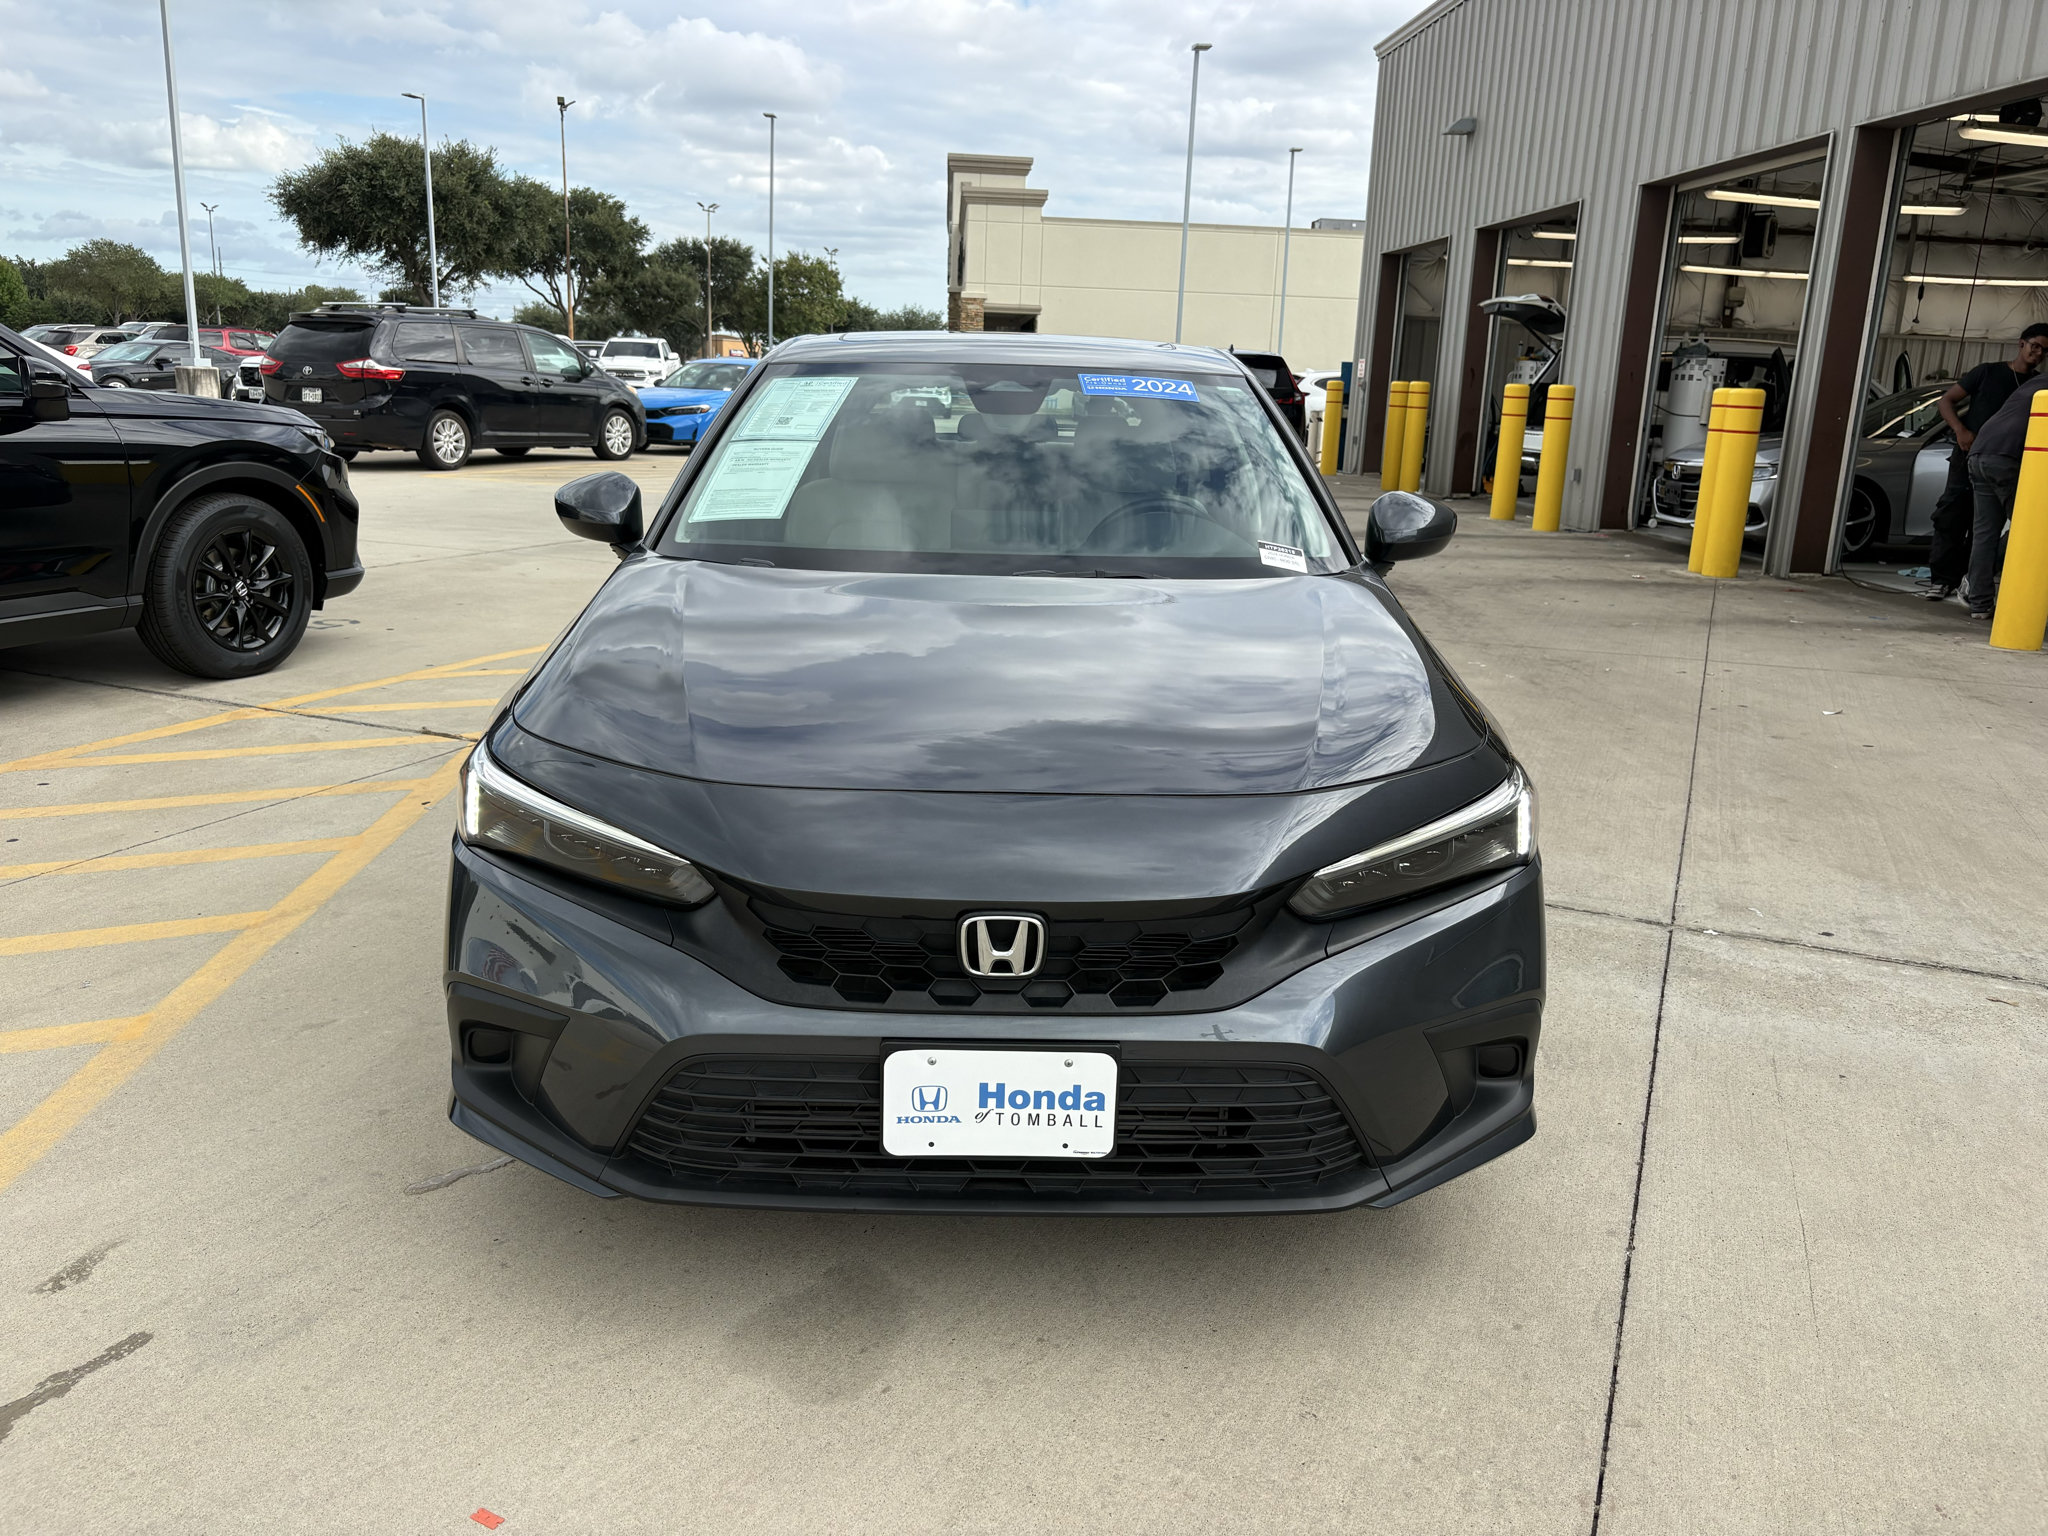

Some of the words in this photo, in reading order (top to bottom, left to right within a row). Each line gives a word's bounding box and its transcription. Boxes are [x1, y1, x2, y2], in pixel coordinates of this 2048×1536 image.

[1131, 378, 1194, 396] 2024
[979, 1083, 1105, 1111] Honda
[896, 1115, 963, 1124] HONDA
[974, 1109, 995, 1124] of
[994, 1112, 1104, 1128] TOMBALL
